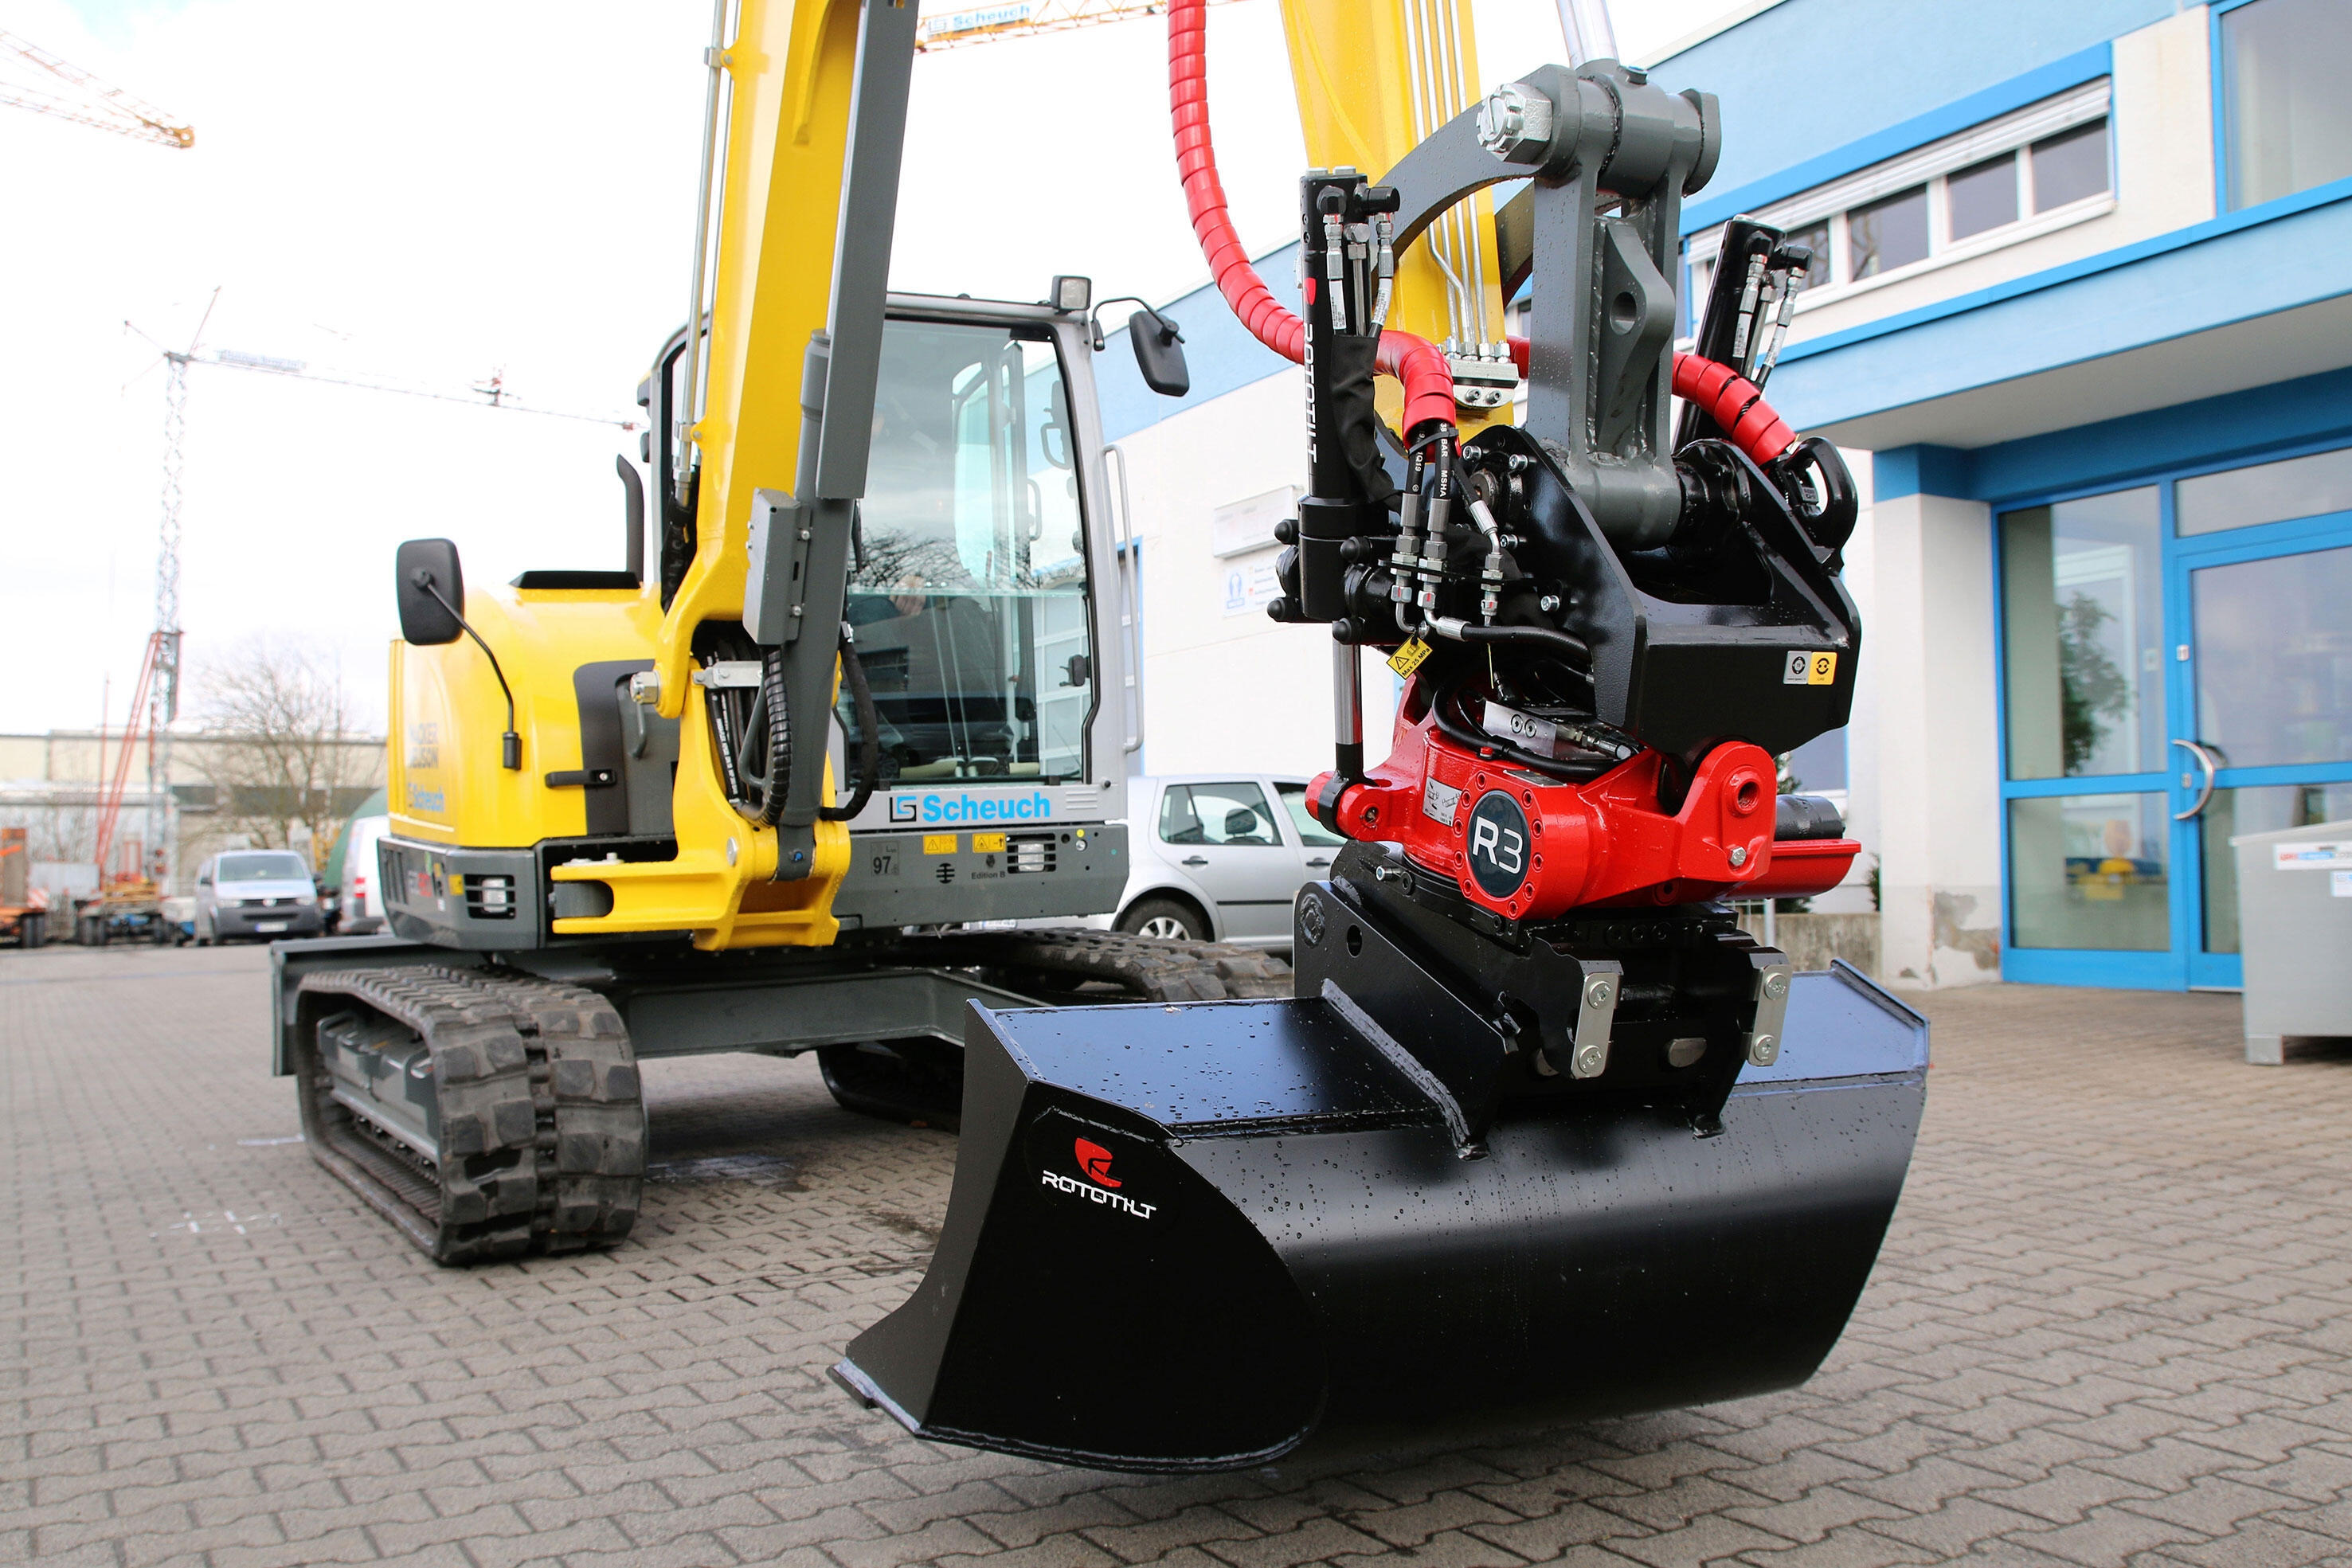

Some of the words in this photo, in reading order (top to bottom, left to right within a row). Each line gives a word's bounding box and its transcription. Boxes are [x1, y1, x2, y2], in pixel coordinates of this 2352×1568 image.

[953, 5, 1031, 29] Scheuch
[1415, 452, 1424, 472] 1Q19
[1439, 470, 1448, 498] MSHA
[1402, 666, 1413, 676] Max
[1418, 647, 1430, 659] MPa
[922, 792, 1051, 823] Scheuch
[1472, 815, 1523, 874] R3
[873, 855, 891, 874] 97
[972, 871, 998, 880] Edition
[1042, 1169, 1157, 1219] ROTOTILT
